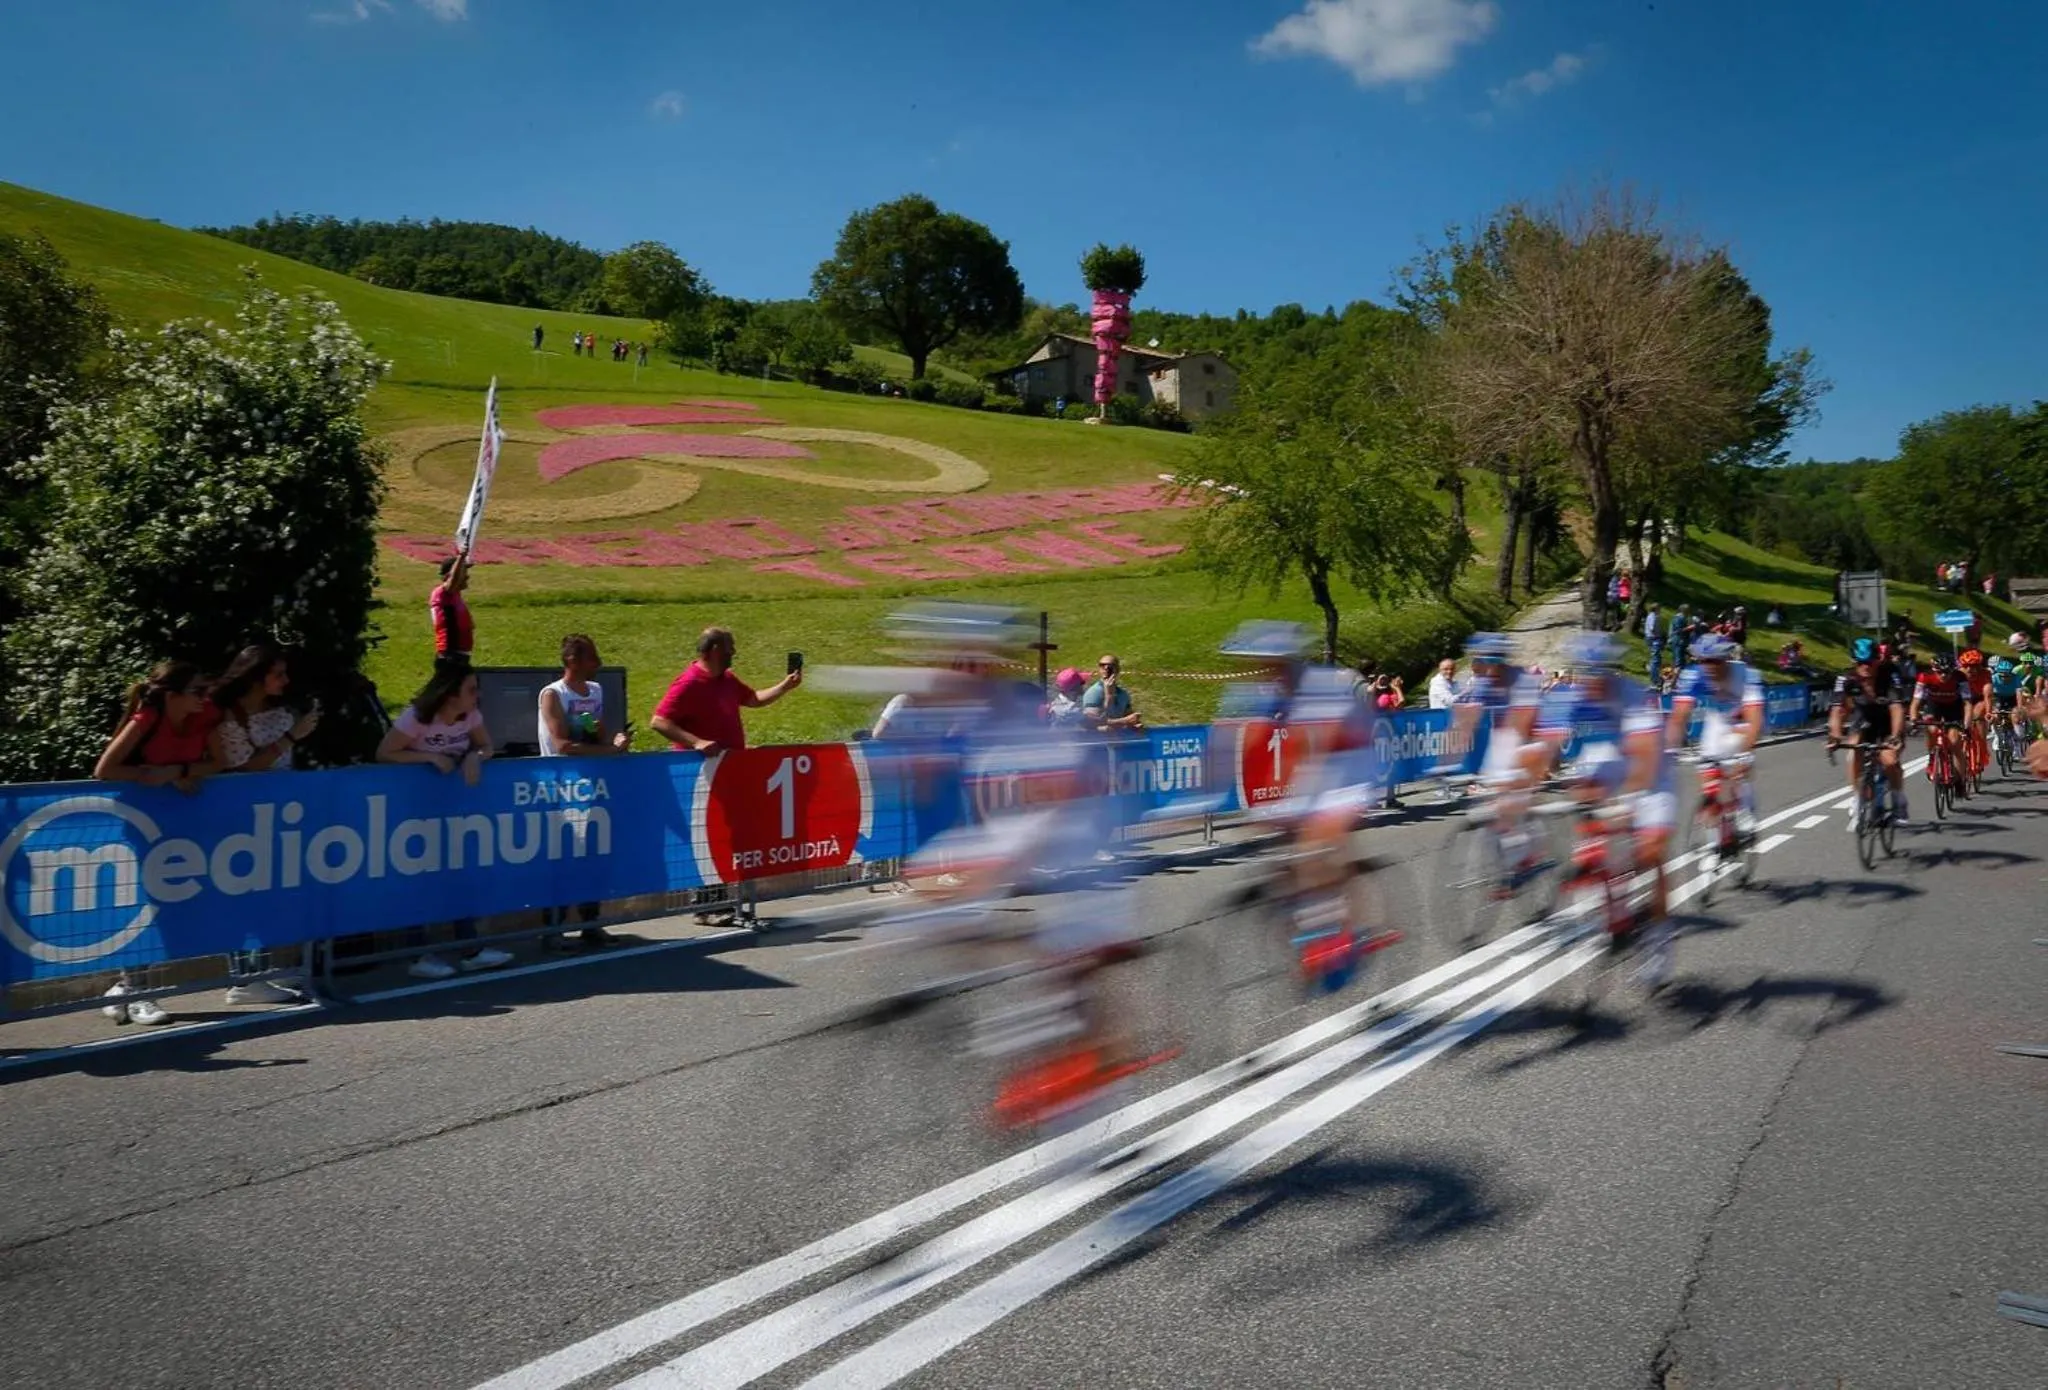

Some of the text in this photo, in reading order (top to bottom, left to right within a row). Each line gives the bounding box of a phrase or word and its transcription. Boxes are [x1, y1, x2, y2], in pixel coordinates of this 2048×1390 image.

[753, 518, 1184, 586] TERME
[1162, 738, 1202, 756] BANCA
[1373, 720, 1475, 764] mediolanum
[513, 778, 611, 806] BANCA
[766, 755, 812, 839] 1°
[26, 795, 612, 916] mediolanum
[732, 834, 841, 871] PER SOLIDITÀ
